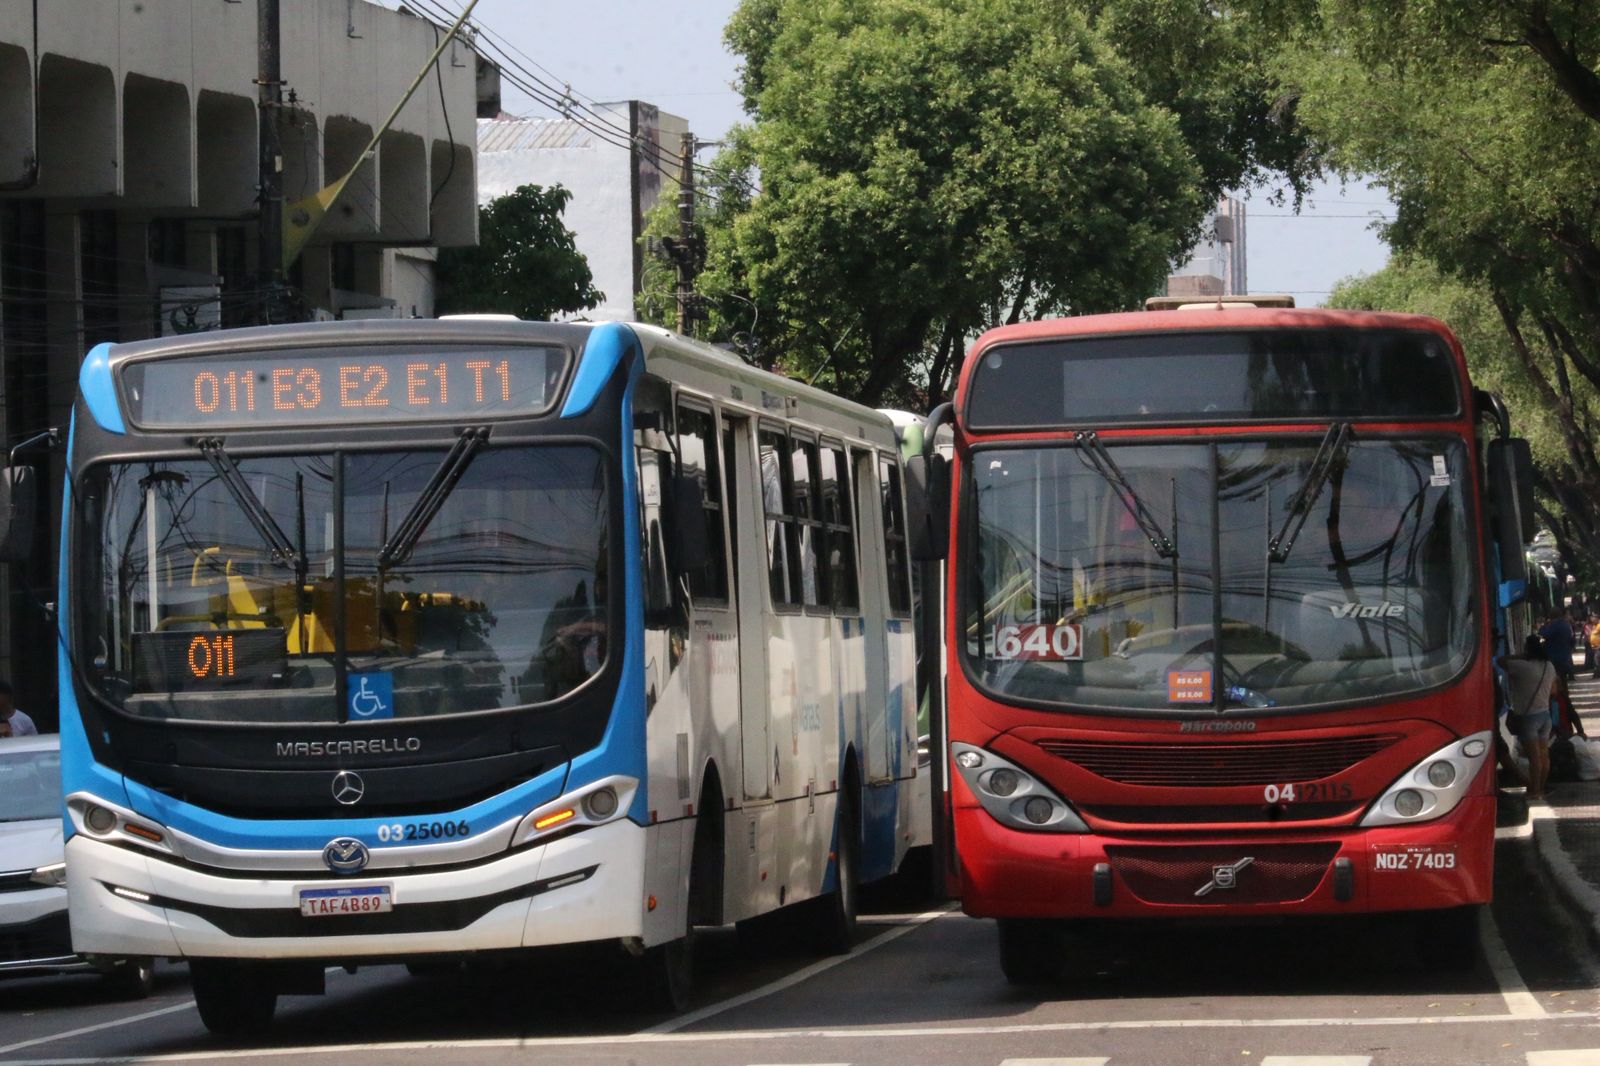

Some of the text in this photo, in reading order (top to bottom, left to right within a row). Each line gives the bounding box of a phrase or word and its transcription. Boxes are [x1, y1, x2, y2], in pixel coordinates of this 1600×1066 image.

[194, 360, 510, 413] 011 E3 E2 E1 T1
[1329, 601, 1405, 619] Viale
[997, 626, 1077, 657] 640
[188, 635, 234, 677] 011
[276, 737, 421, 757] MASCARELLO
[308, 896, 380, 914] TAF4B89
